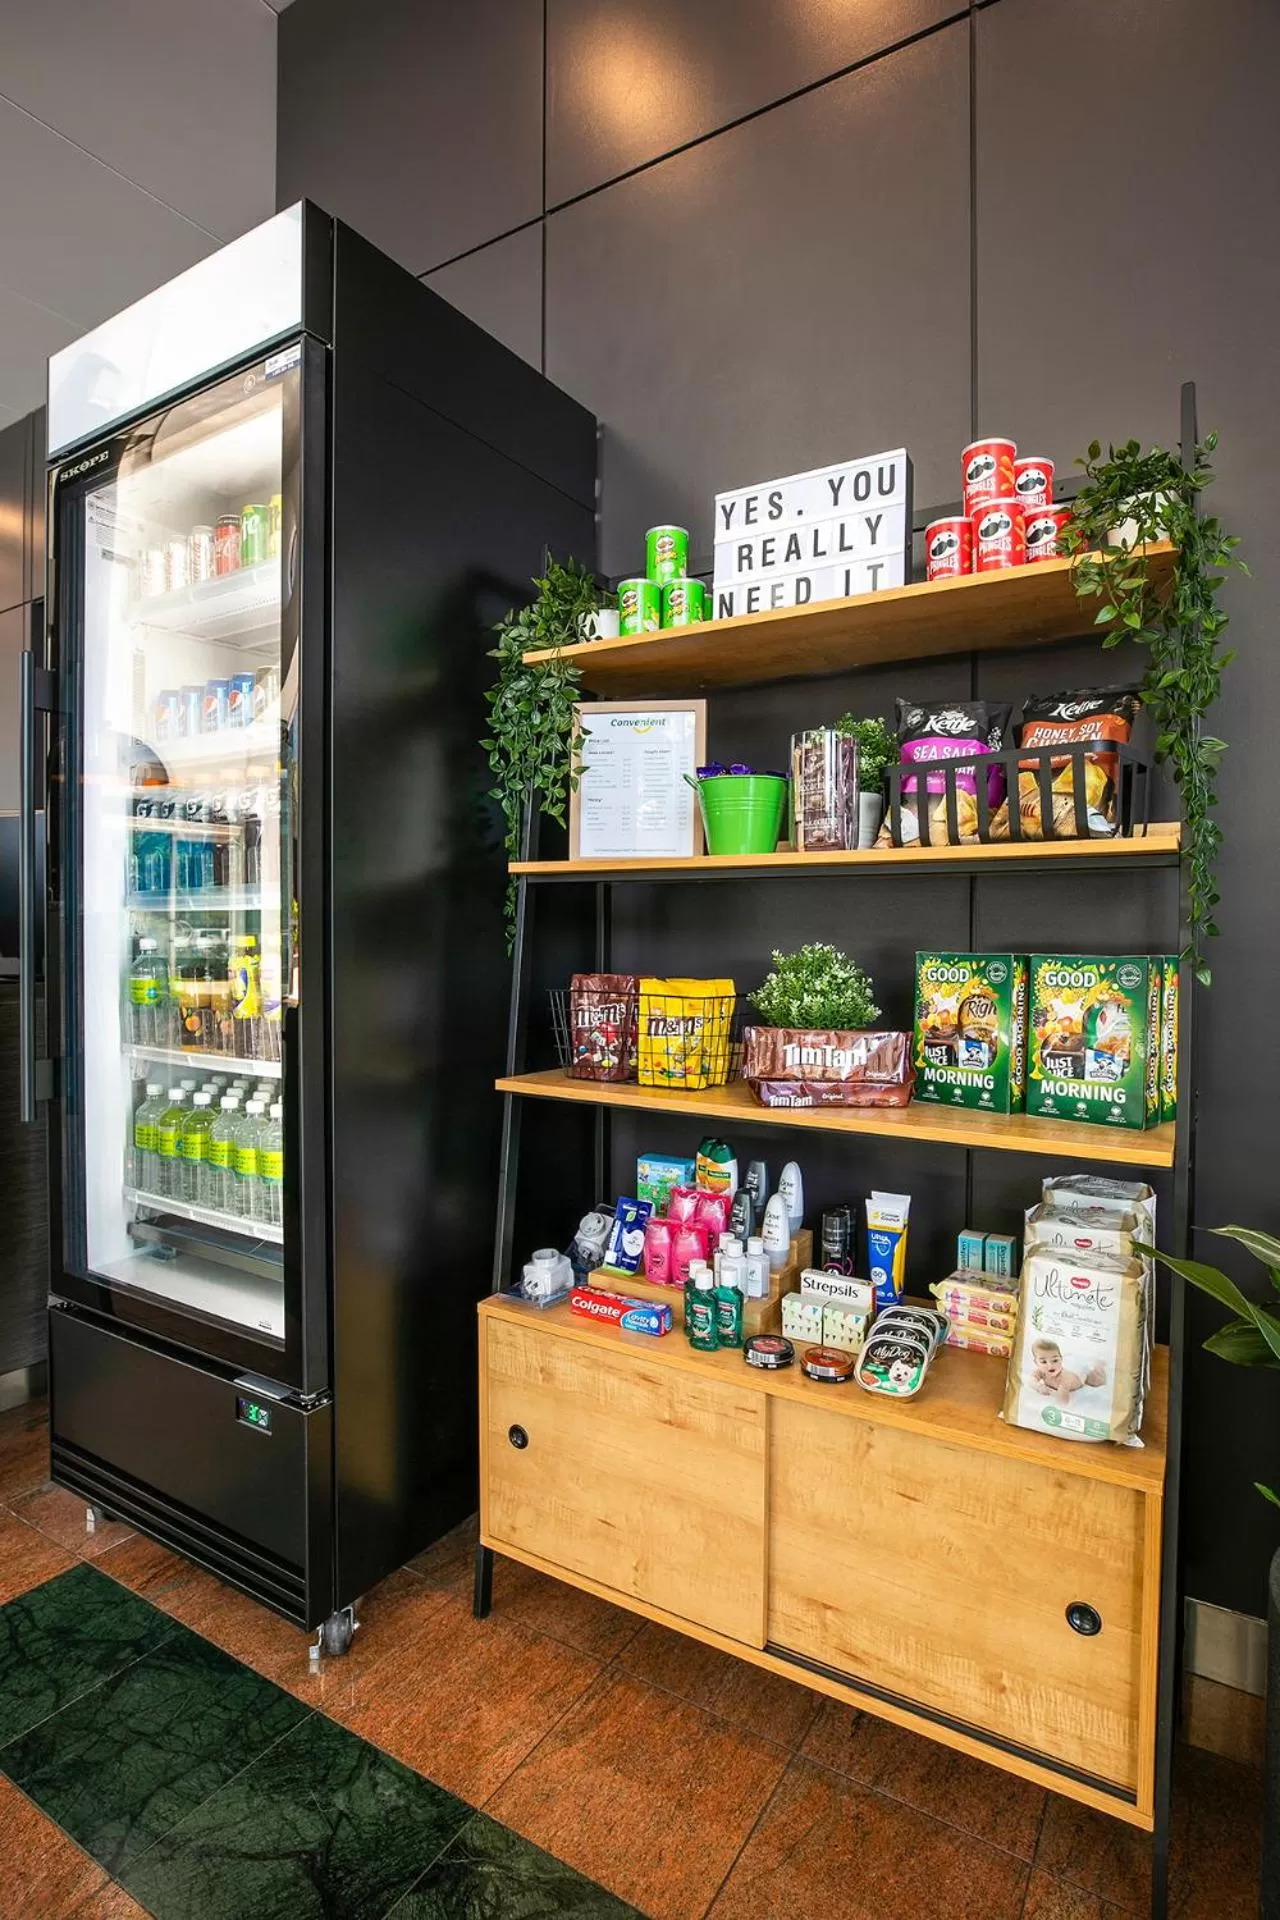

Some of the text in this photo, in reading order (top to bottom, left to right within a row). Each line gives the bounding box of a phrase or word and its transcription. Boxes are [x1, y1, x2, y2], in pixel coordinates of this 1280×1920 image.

[60, 451, 109, 482] SKOPE
[721, 464, 895, 530] YES. YOU
[737, 514, 883, 572] REALLY
[719, 563, 884, 618] NEED IT
[1034, 721, 1104, 740] HONEY SOY
[913, 744, 938, 760] SEA
[927, 967, 970, 983] GOOD
[1045, 971, 1097, 988] GOOD
[1167, 987, 1175, 1050] MORNING
[1016, 983, 1025, 1084] GOOD MORNING
[1046, 1056, 1073, 1069] JUST
[924, 1067, 994, 1090] MORNING
[1041, 1079, 1127, 1103] MORNING
[803, 1277, 859, 1298] Strepsils
[1034, 1268, 1114, 1312] Ultimate
[571, 1296, 621, 1318] Colgate
